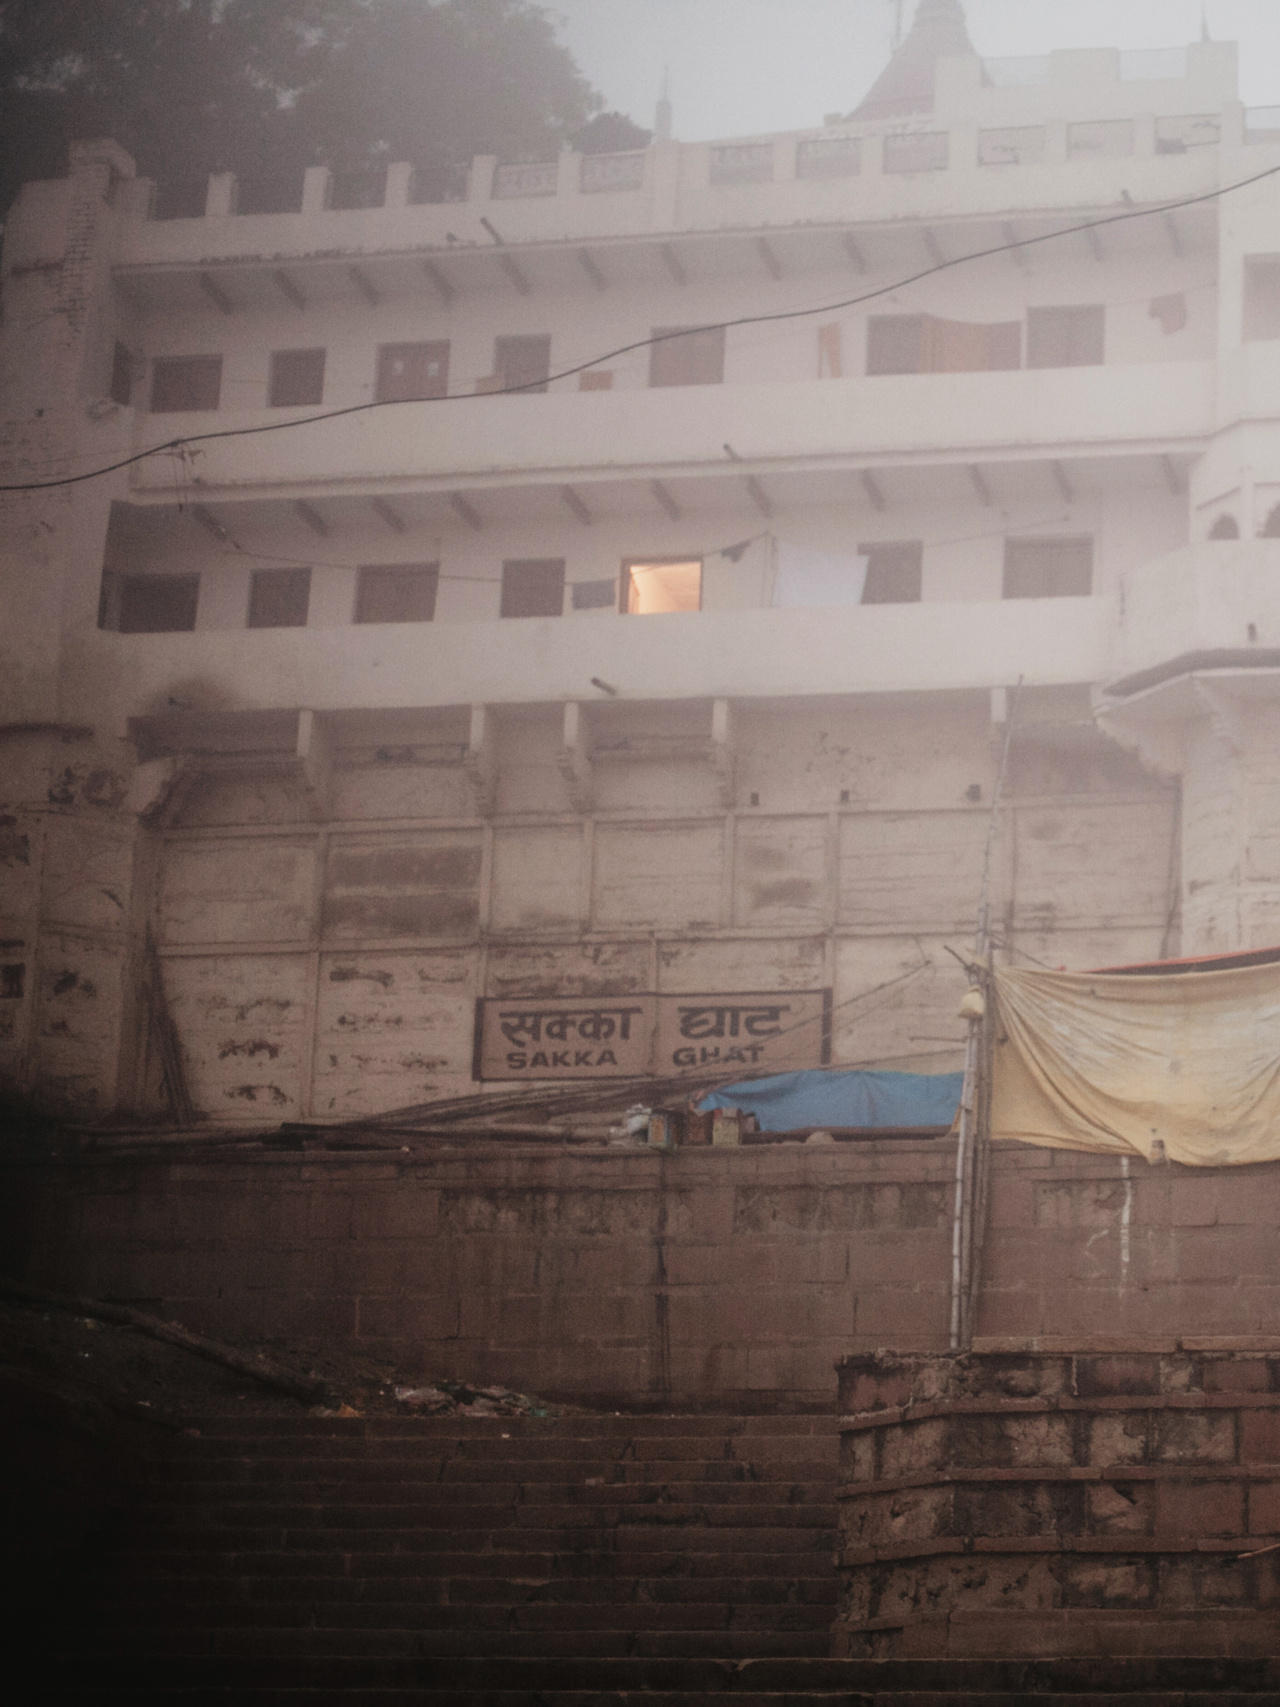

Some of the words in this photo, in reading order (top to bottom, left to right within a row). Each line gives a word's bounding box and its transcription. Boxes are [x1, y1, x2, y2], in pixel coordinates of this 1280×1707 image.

[499, 1006, 644, 1048] सक्का
[676, 1004, 791, 1040] घाट
[507, 1049, 618, 1070] SAKKA
[672, 1045, 765, 1067] GHAT
